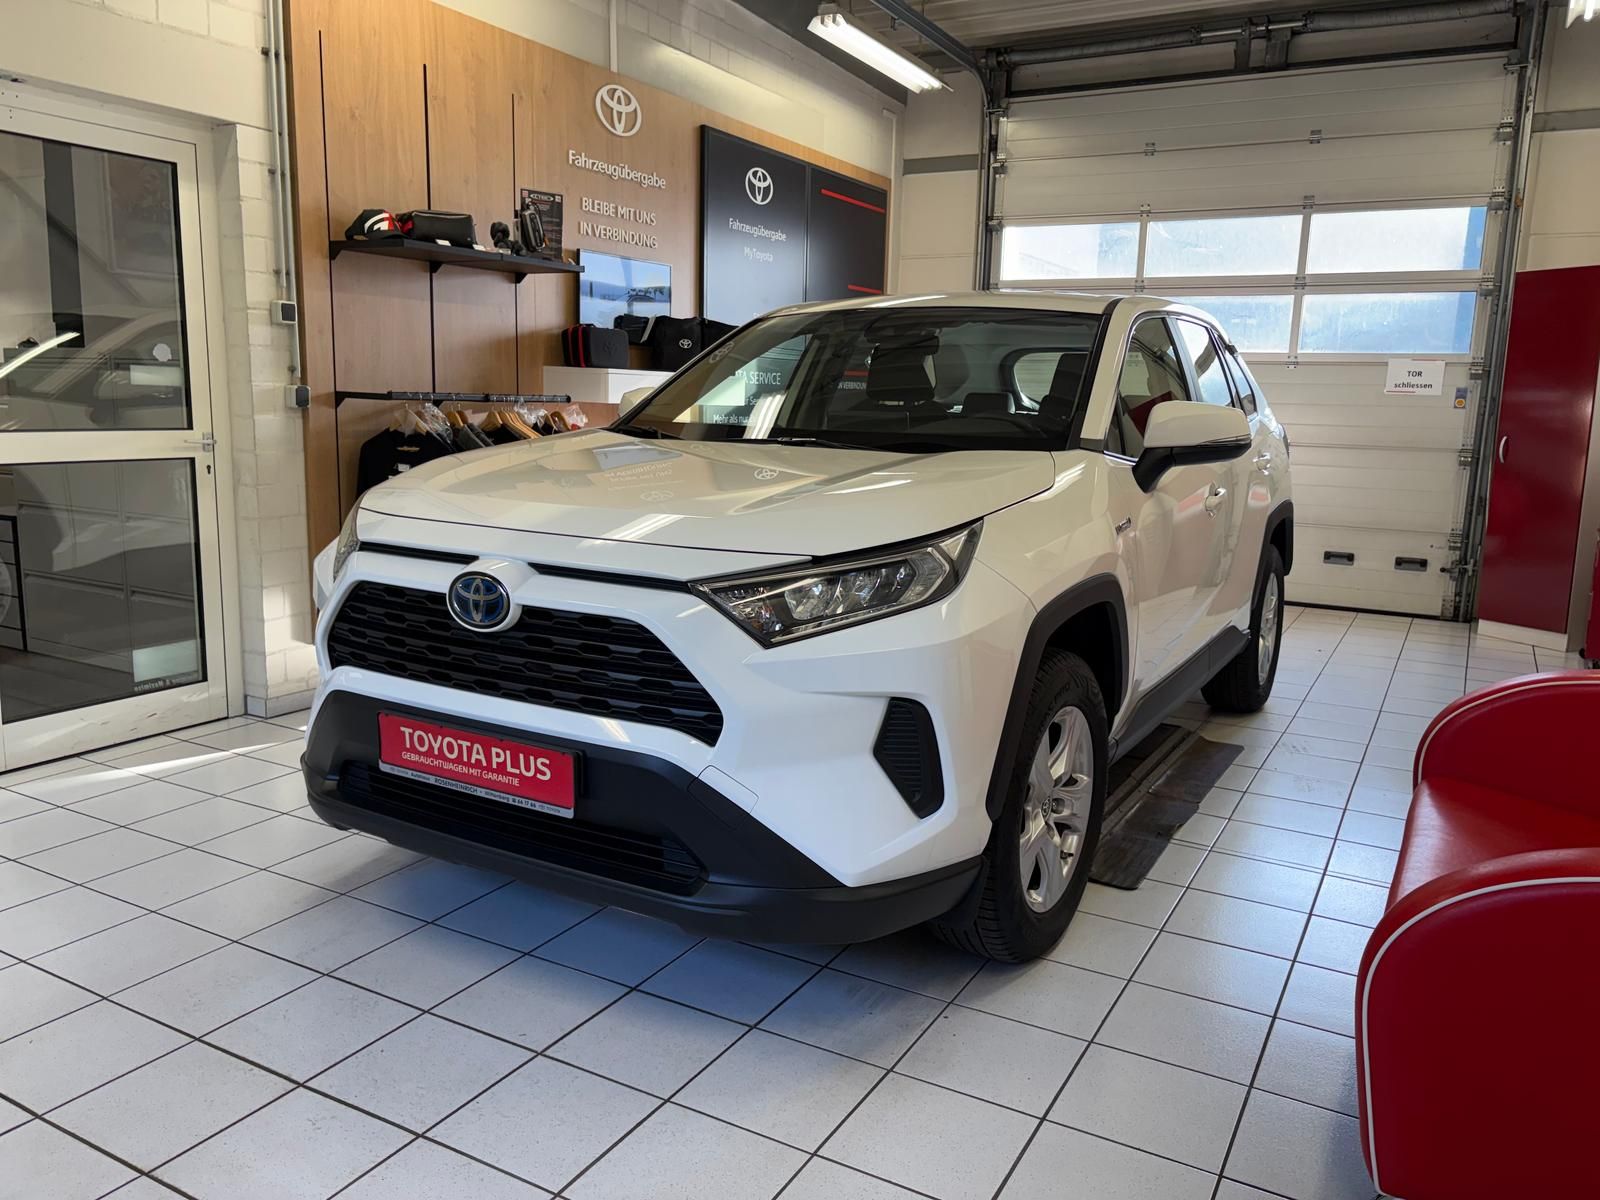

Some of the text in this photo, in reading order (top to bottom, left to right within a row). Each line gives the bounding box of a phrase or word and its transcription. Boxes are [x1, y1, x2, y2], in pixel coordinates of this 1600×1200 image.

[569, 150, 666, 189] Fahrzeugübergabe
[582, 197, 656, 226] BLEIBE MIT UNS
[580, 221, 658, 249] IN VERBINDUNG
[729, 217, 787, 242] Fahrzeugübergabe
[744, 246, 774, 263] MyToyota
[749, 371, 782, 385] SERVICE
[1394, 381, 1433, 390] schliessen
[1407, 370, 1423, 378] TOR
[713, 414, 729, 425] Mehr
[400, 726, 551, 782] TOYOTA PLUS
[401, 751, 469, 775] GEBRAUCHTWAGEN
[469, 766, 482, 778] MIT
[482, 769, 520, 787] GARANTIE
